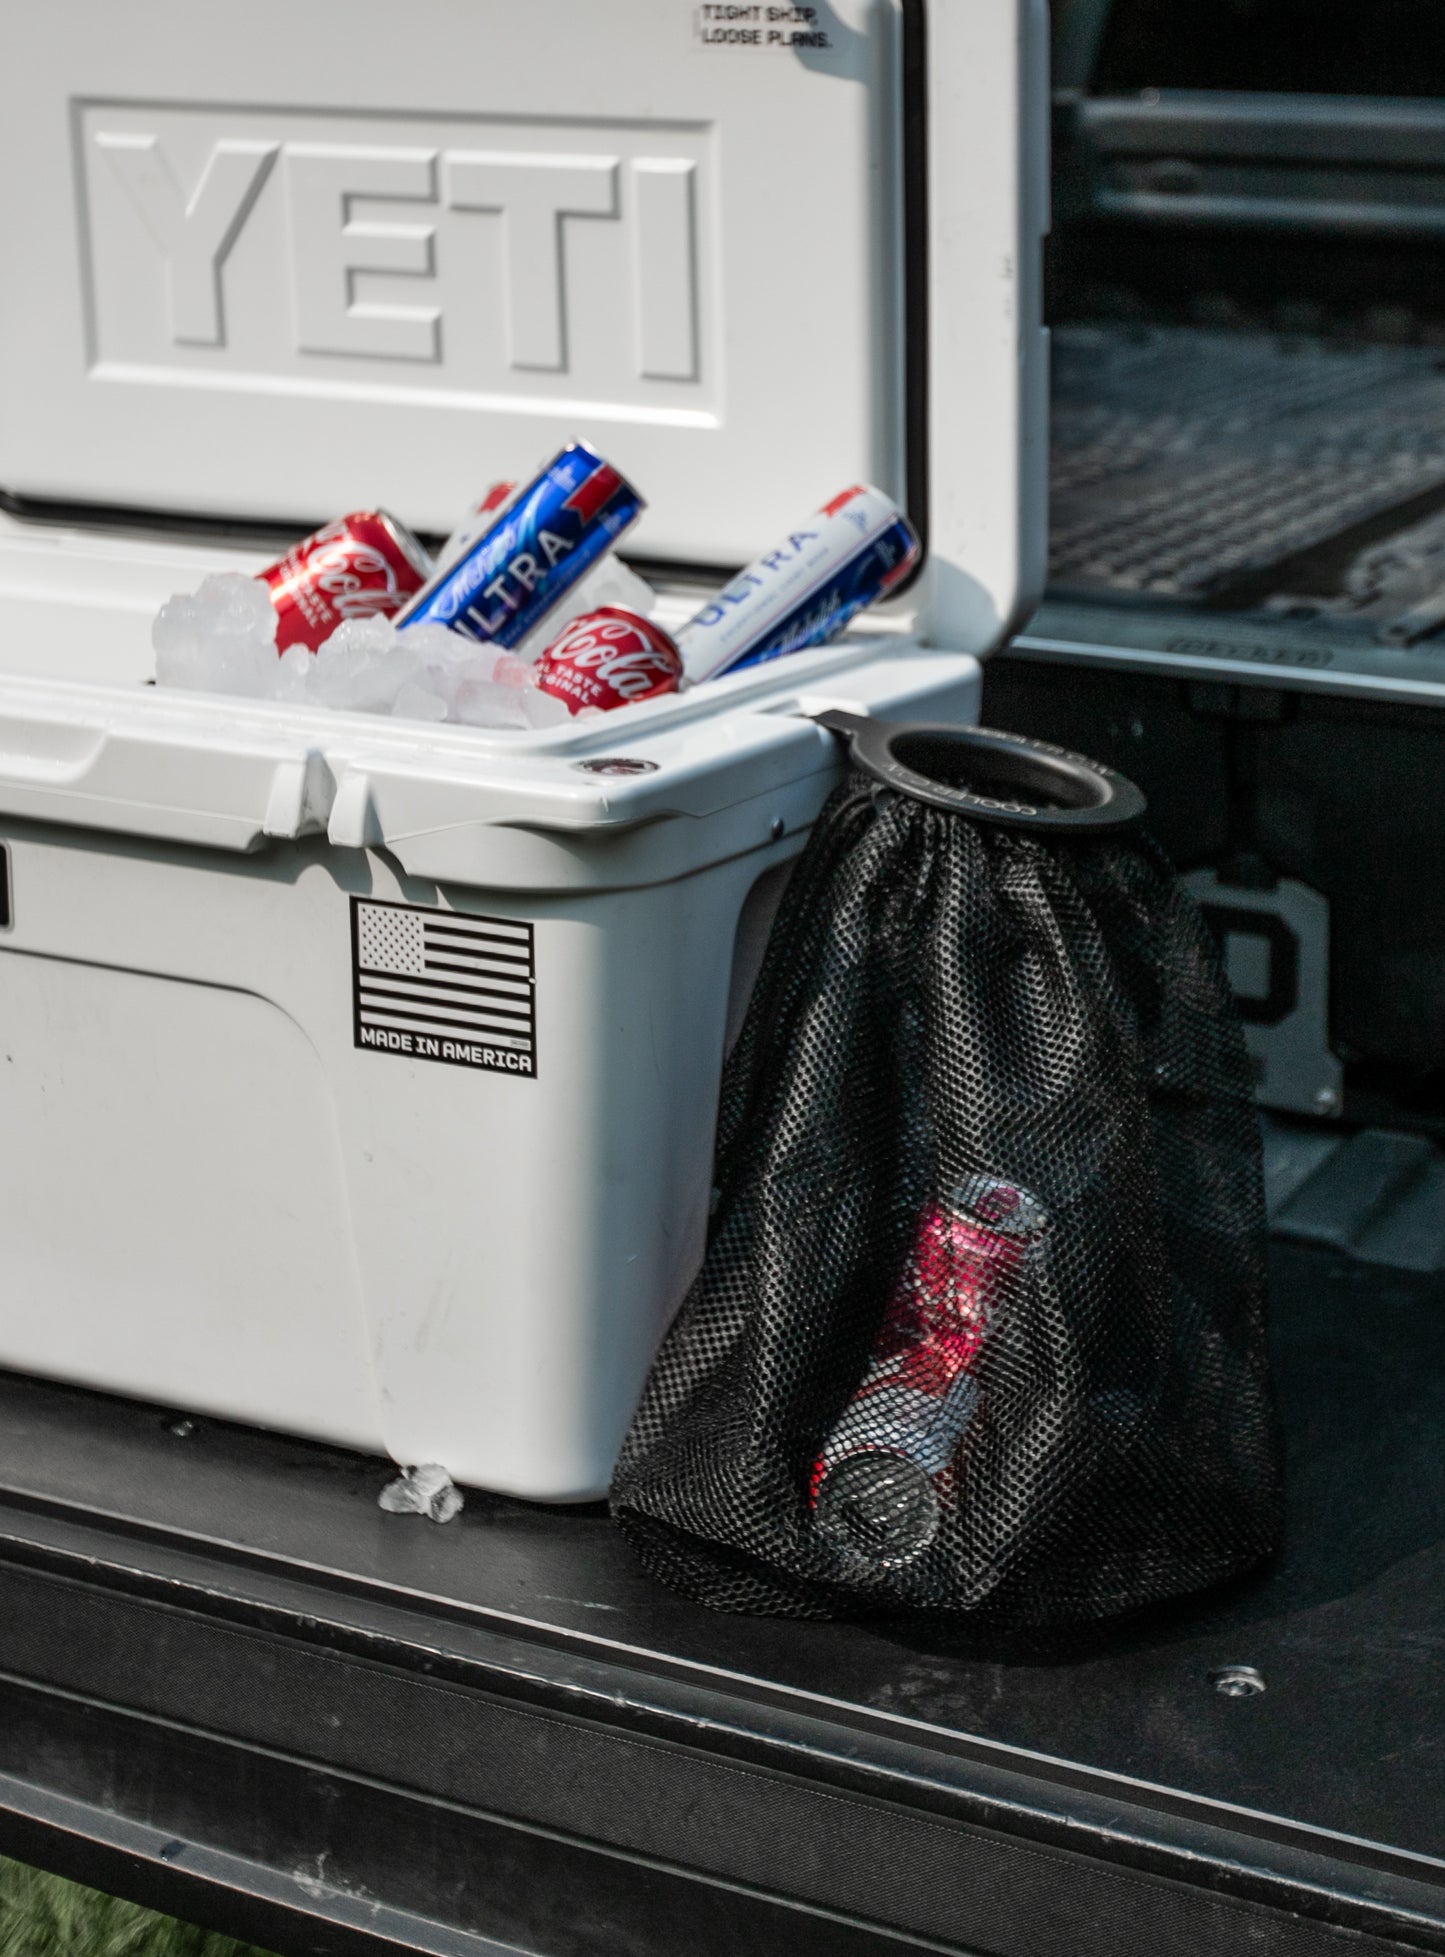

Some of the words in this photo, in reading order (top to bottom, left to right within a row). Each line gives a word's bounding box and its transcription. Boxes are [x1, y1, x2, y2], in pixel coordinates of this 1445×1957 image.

[702, 4, 761, 21] TIGHT
[702, 28, 762, 45] LOOSE
[767, 29, 833, 48] PLANS.
[95, 131, 701, 384] YETI
[694, 530, 820, 627] ULTRA
[551, 618, 673, 700] Cola
[544, 673, 590, 704] GINAL
[556, 663, 603, 698] TASTE
[360, 1025, 413, 1052] MADE
[415, 1035, 440, 1056] IN
[442, 1040, 532, 1073] AMERICA
